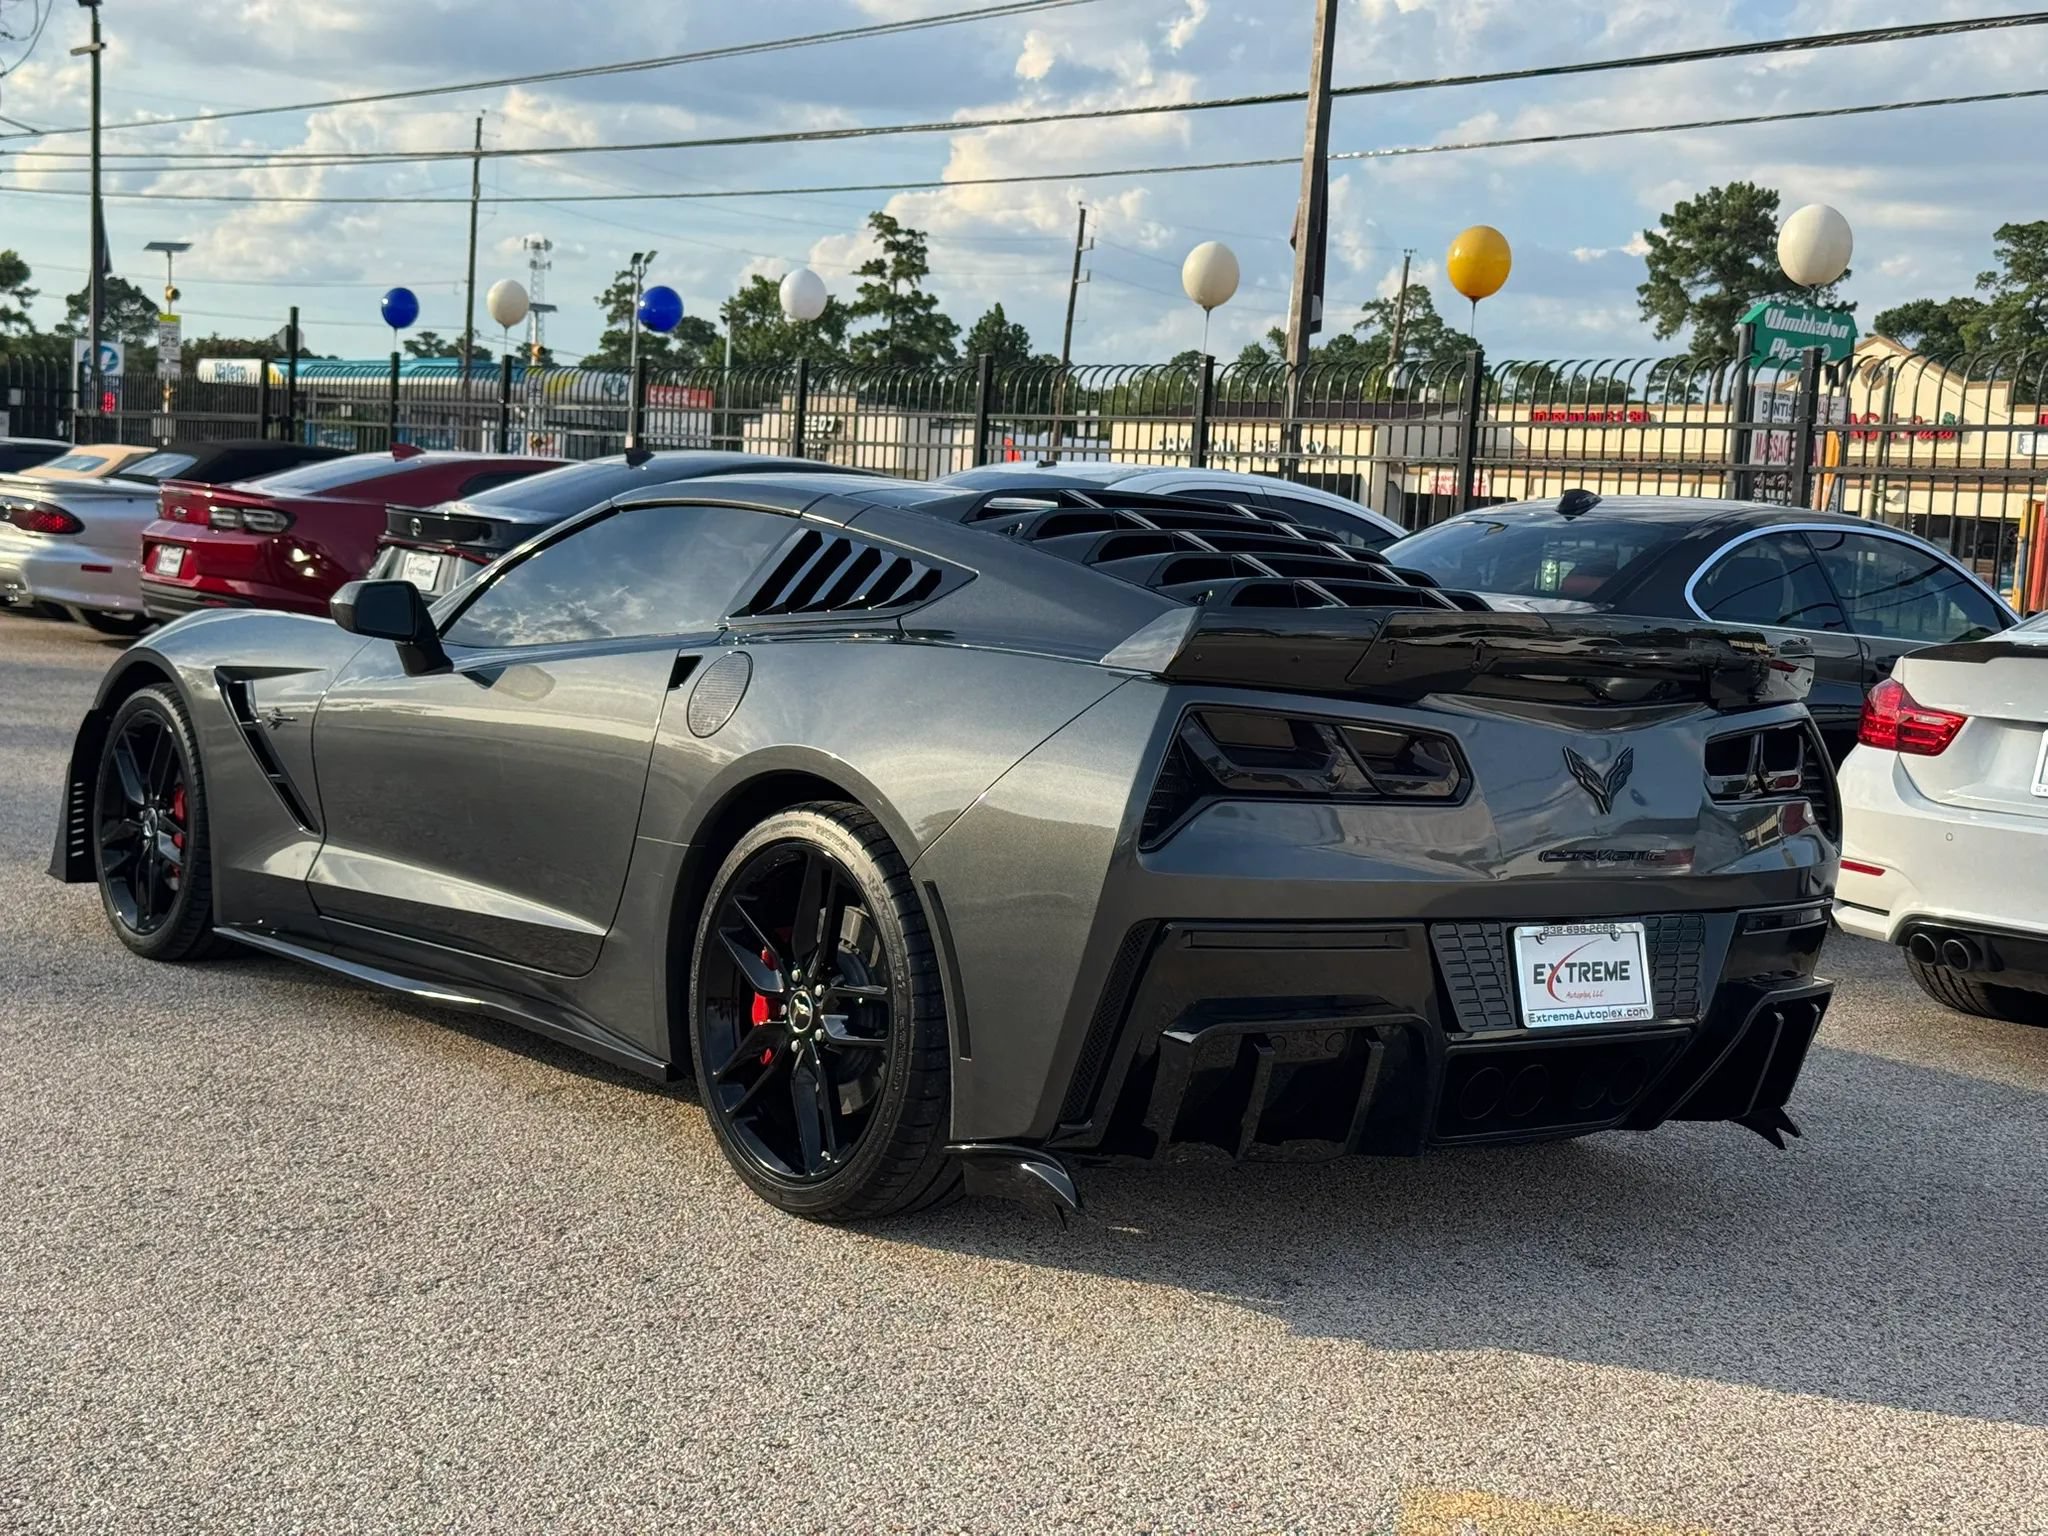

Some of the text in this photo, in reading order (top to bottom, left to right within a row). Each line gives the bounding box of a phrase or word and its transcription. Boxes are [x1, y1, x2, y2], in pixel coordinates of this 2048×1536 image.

[1765, 307, 1850, 339] Wimbledon
[161, 335, 179, 348] 25
[214, 361, 247, 381] Valero
[1533, 960, 1630, 985] EXTREME
[1528, 1006, 1649, 1024] ExtremeAutoplex.com
